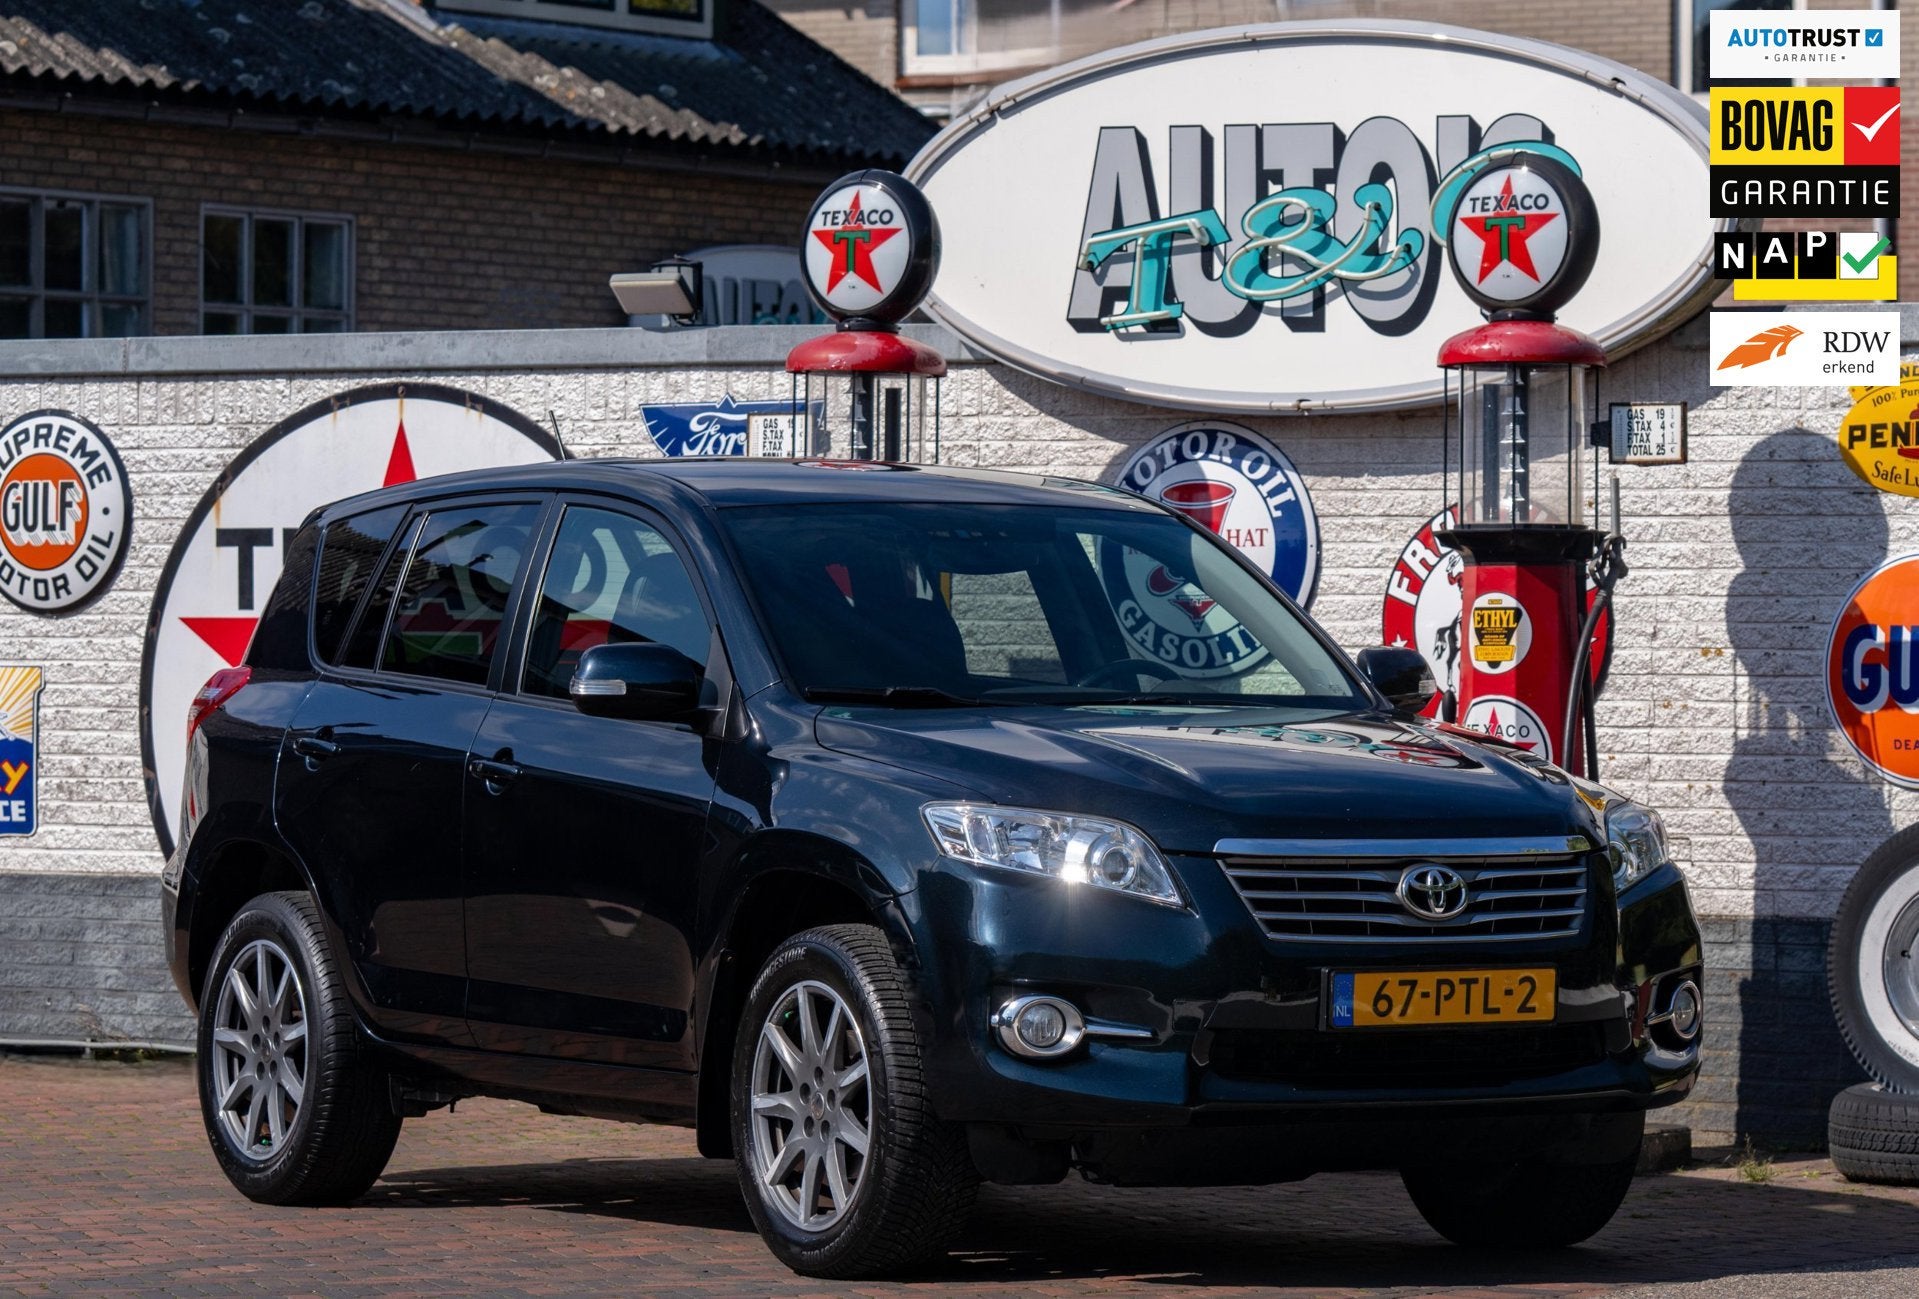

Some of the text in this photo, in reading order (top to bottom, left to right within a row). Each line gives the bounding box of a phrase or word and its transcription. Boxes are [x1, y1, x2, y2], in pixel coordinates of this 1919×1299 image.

[1469, 193, 1549, 213] TEXACO
[821, 209, 894, 227] TEXACO
[1901, 387, 1919, 398] Pur
[763, 418, 779, 429] GAS
[1627, 409, 1665, 420] GAS 19
[682, 411, 748, 456] For
[762, 429, 785, 441] S.TAX
[1660, 421, 1666, 431] 4
[762, 441, 783, 451] F.TAX
[1627, 445, 1666, 456] TOTAL 25
[0, 423, 113, 491] UPREME
[1872, 460, 1902, 485] Safe
[1240, 450, 1296, 519] OIL
[2, 480, 80, 540] GULF
[1227, 528, 1269, 547] HAT
[0, 531, 114, 601] OTOR OIL
[1474, 609, 1518, 629] ETHYL
[1467, 723, 1531, 739] EXACO
[1372, 975, 1537, 1018] 67-PTL-2
[1335, 1005, 1351, 1017] NL
